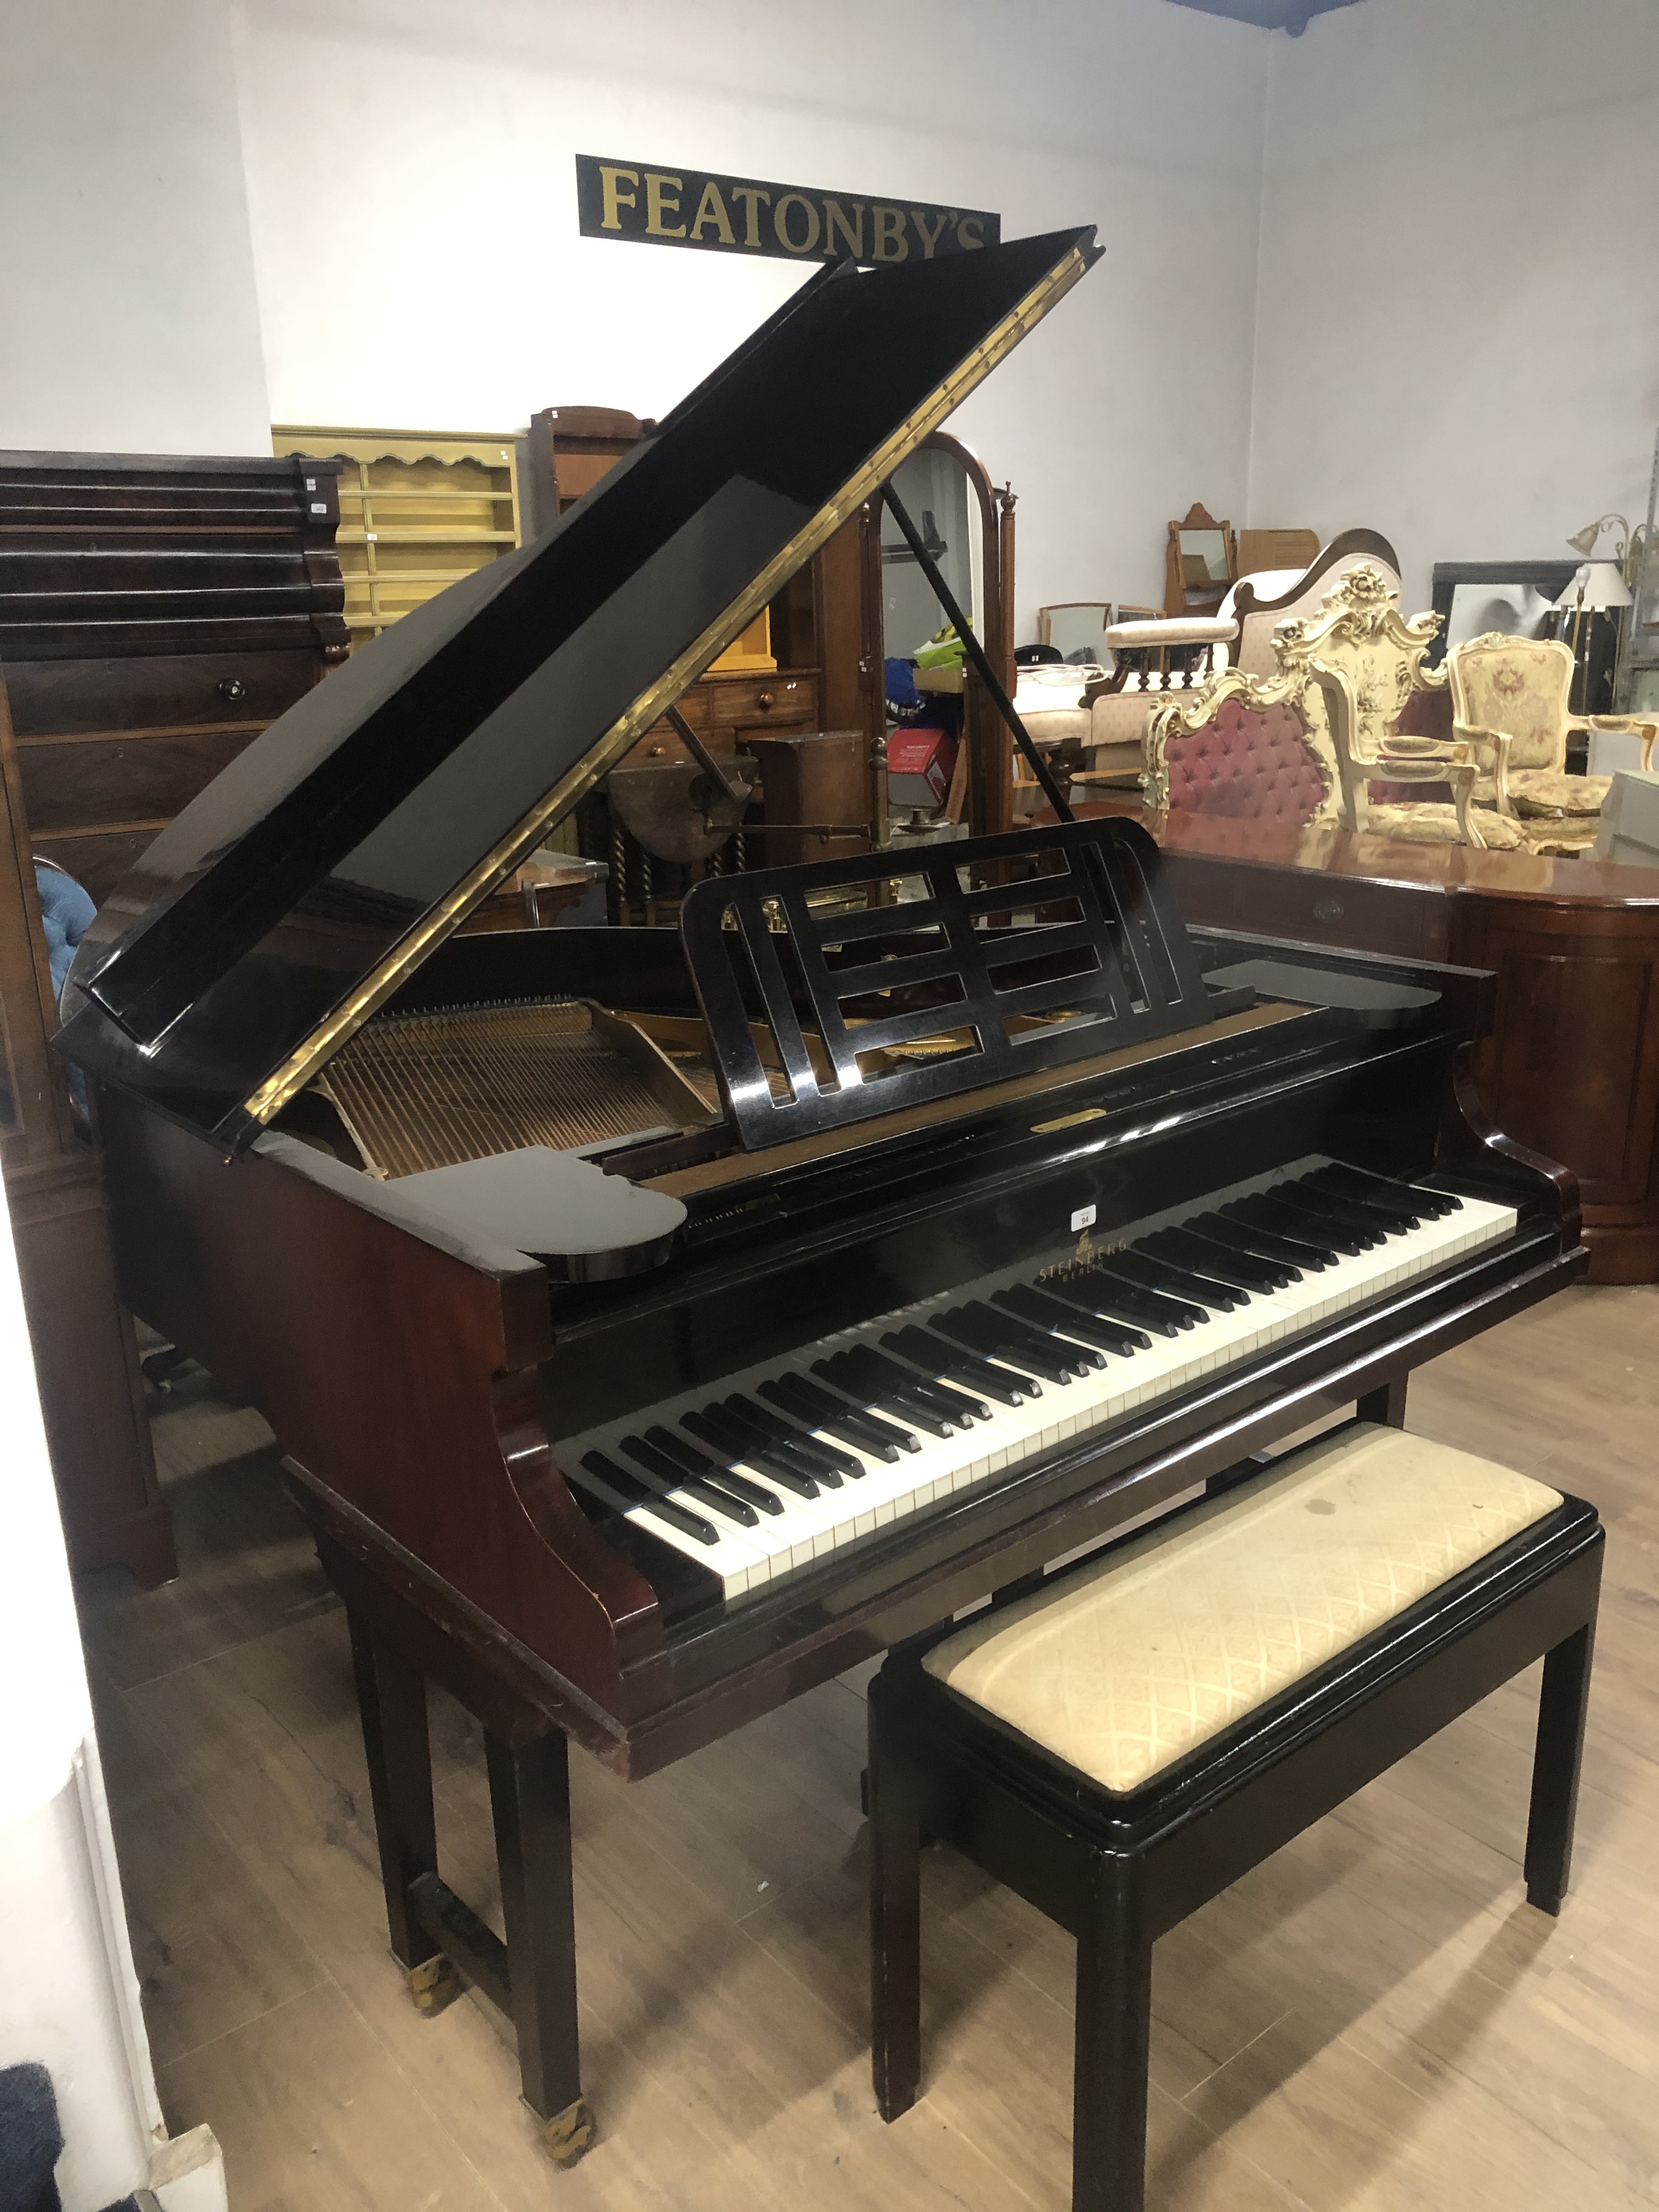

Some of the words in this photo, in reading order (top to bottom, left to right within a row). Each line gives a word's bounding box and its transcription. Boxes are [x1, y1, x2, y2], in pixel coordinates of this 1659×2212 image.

[600, 166, 985, 264] FEATONBY'S
[1081, 1216, 1089, 1224] 94
[1039, 1238, 1127, 1283] STEINBERG
[1062, 1261, 1104, 1283] BERLIN
